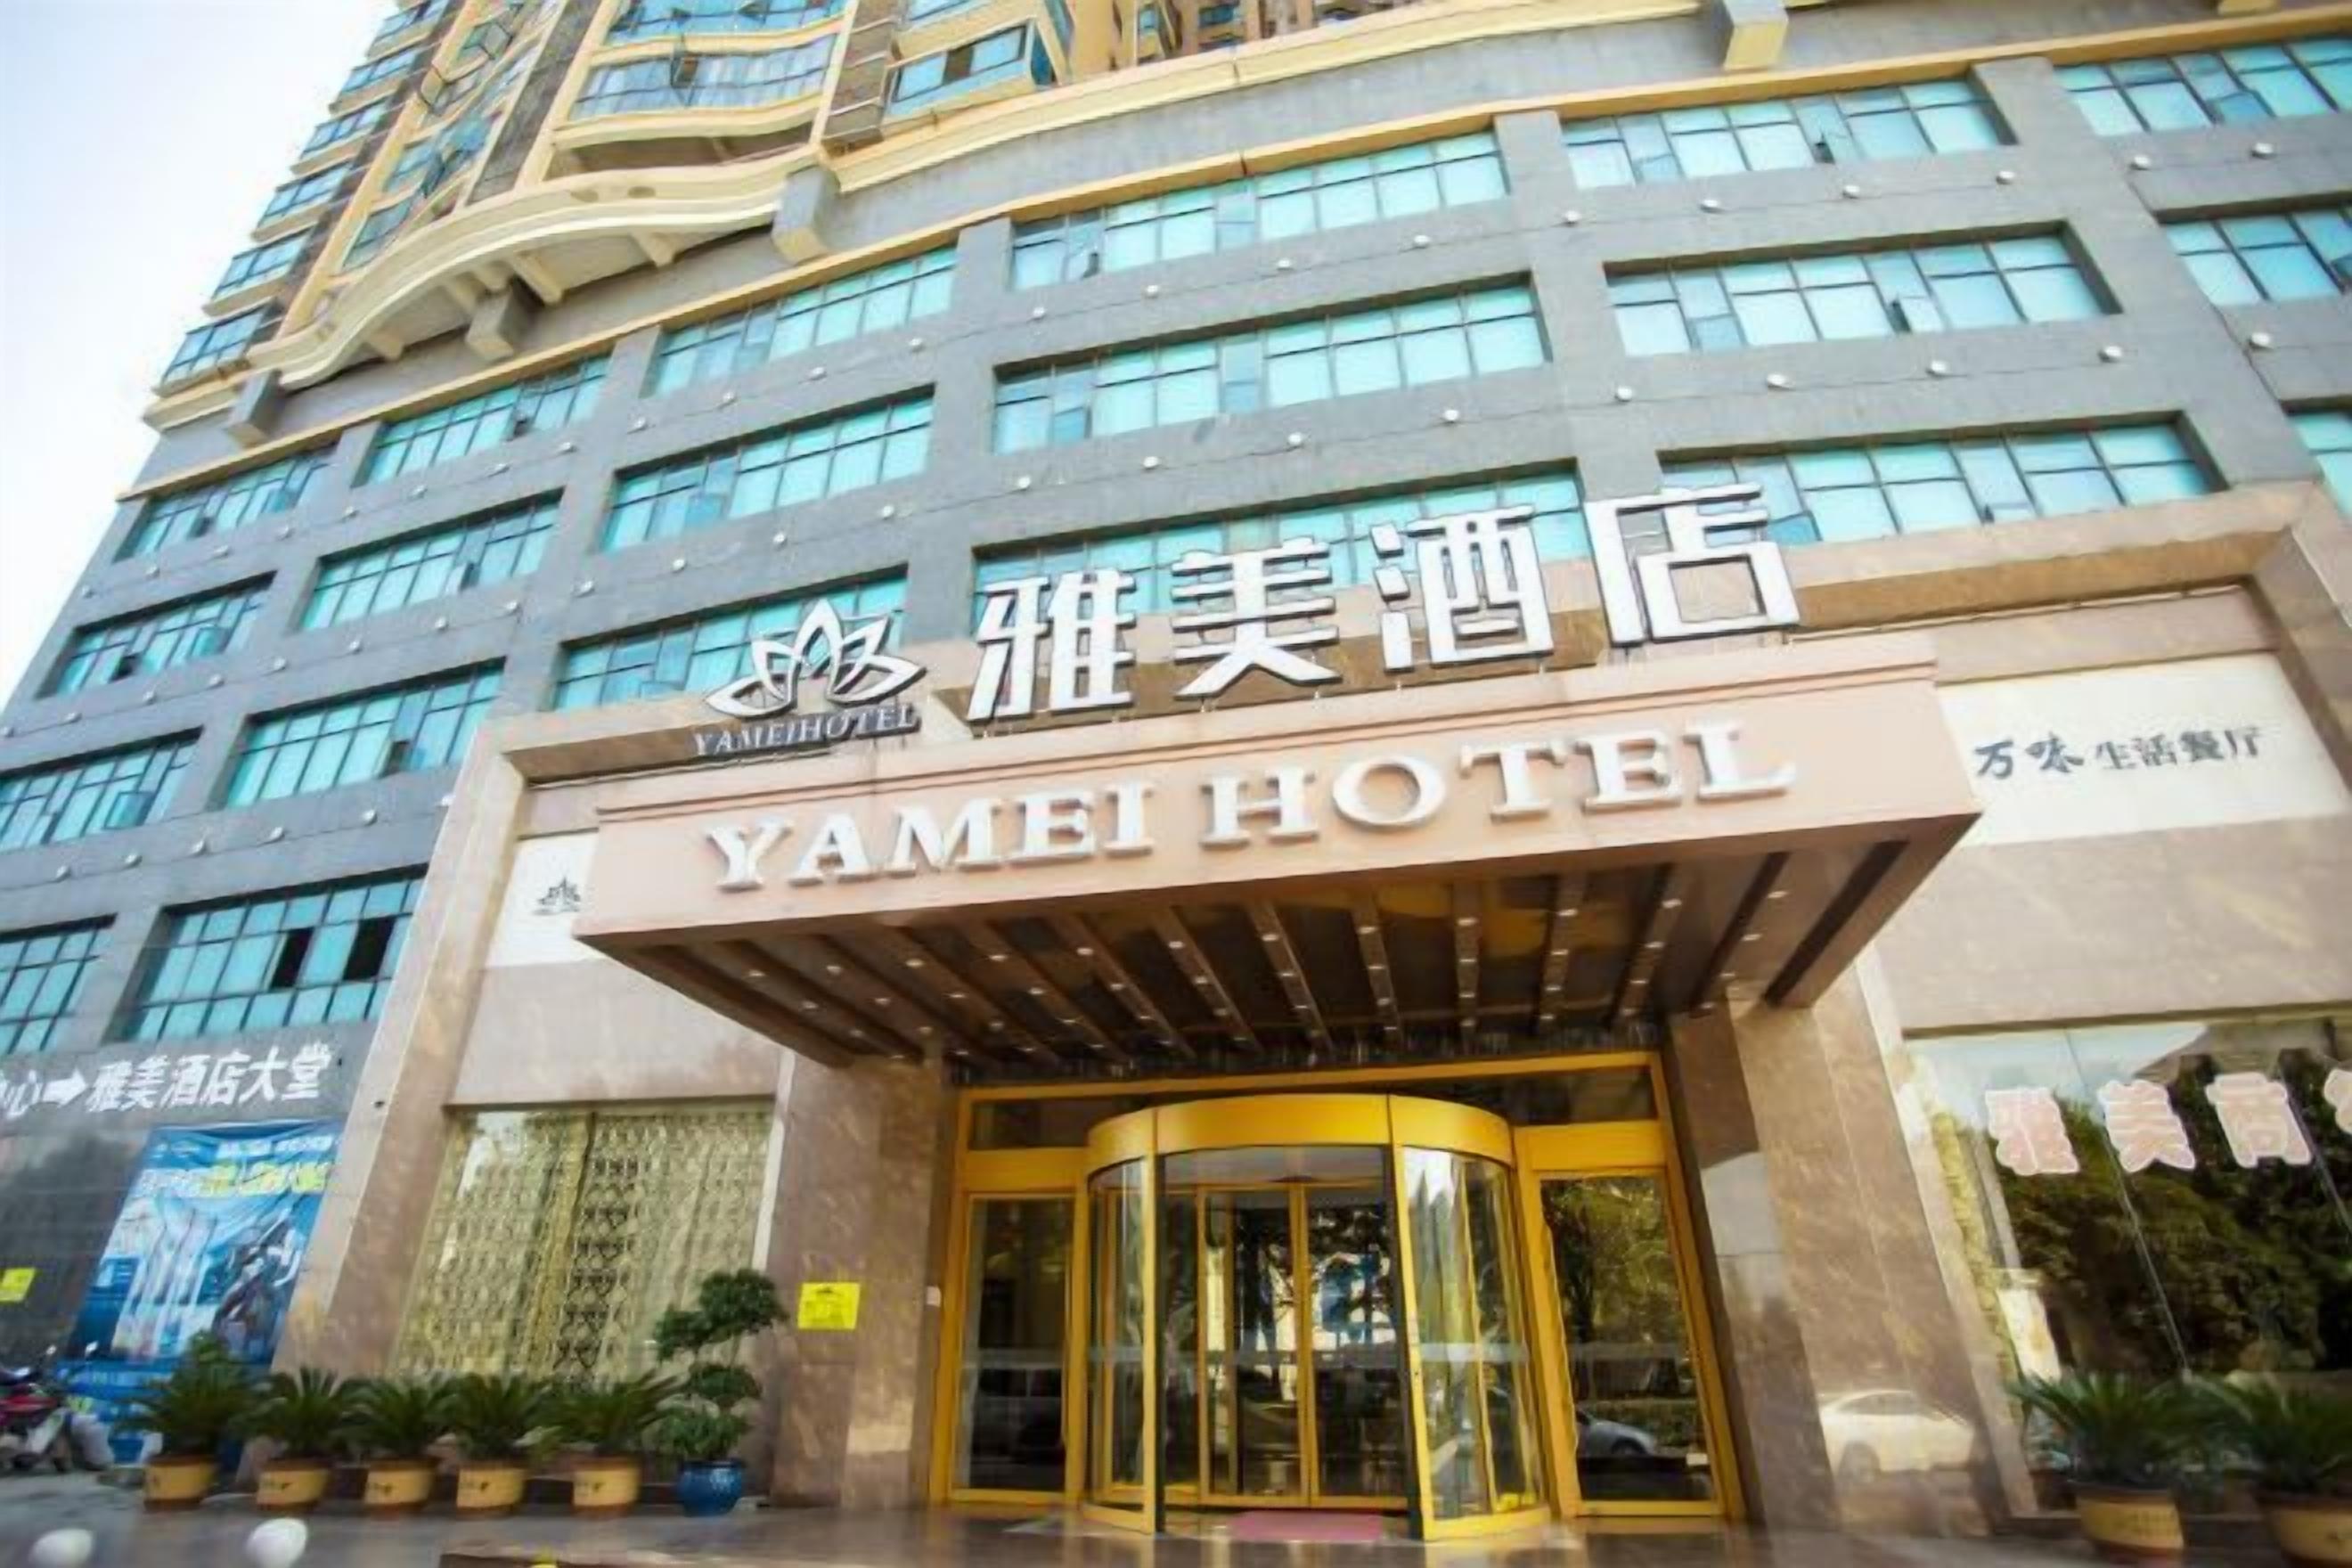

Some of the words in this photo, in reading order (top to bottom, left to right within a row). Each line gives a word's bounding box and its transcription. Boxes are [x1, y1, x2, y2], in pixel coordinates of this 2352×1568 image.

[967, 484, 1800, 723] 雅美酒店
[708, 780, 1153, 891] YAMEI
[1203, 723, 1795, 847] HOTEL
[87, 1041, 332, 1114] 雅美酒店大堂
